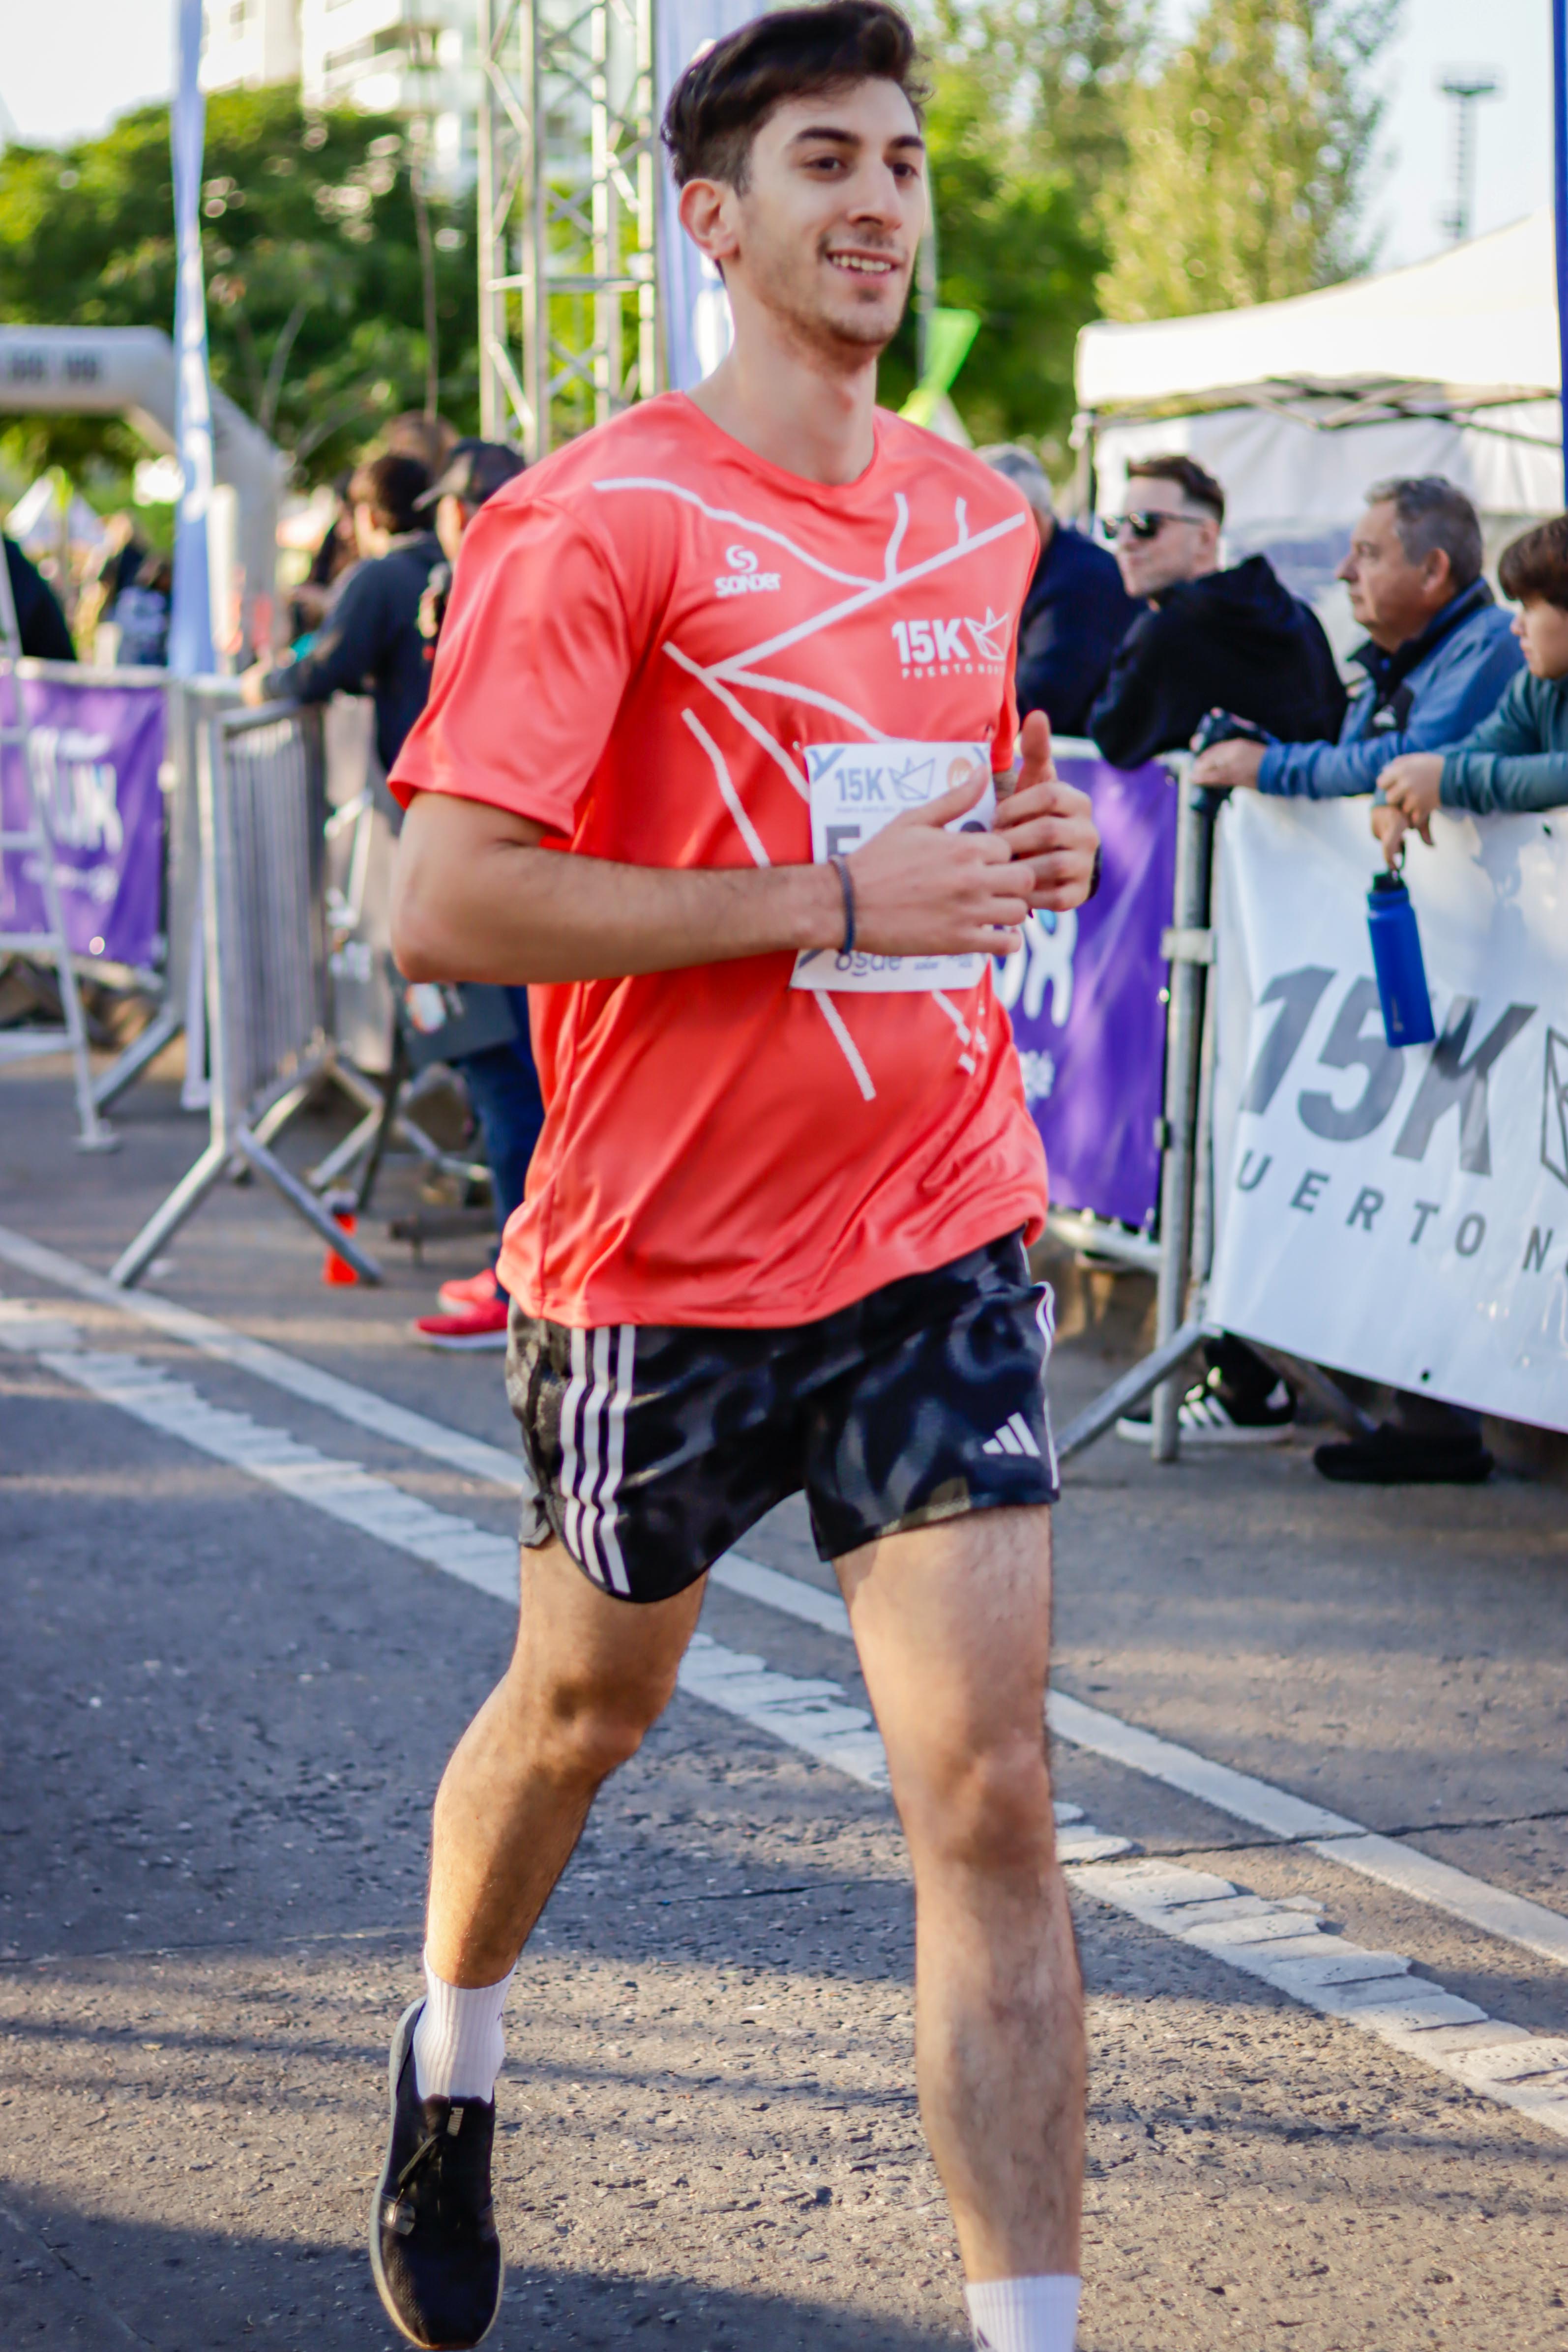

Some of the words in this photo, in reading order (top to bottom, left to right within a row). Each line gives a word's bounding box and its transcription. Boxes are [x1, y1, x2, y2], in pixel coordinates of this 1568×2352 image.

[891, 618, 970, 664] 15K
[834, 767, 887, 801] 15K
[1239, 964, 1538, 1177] 15K
